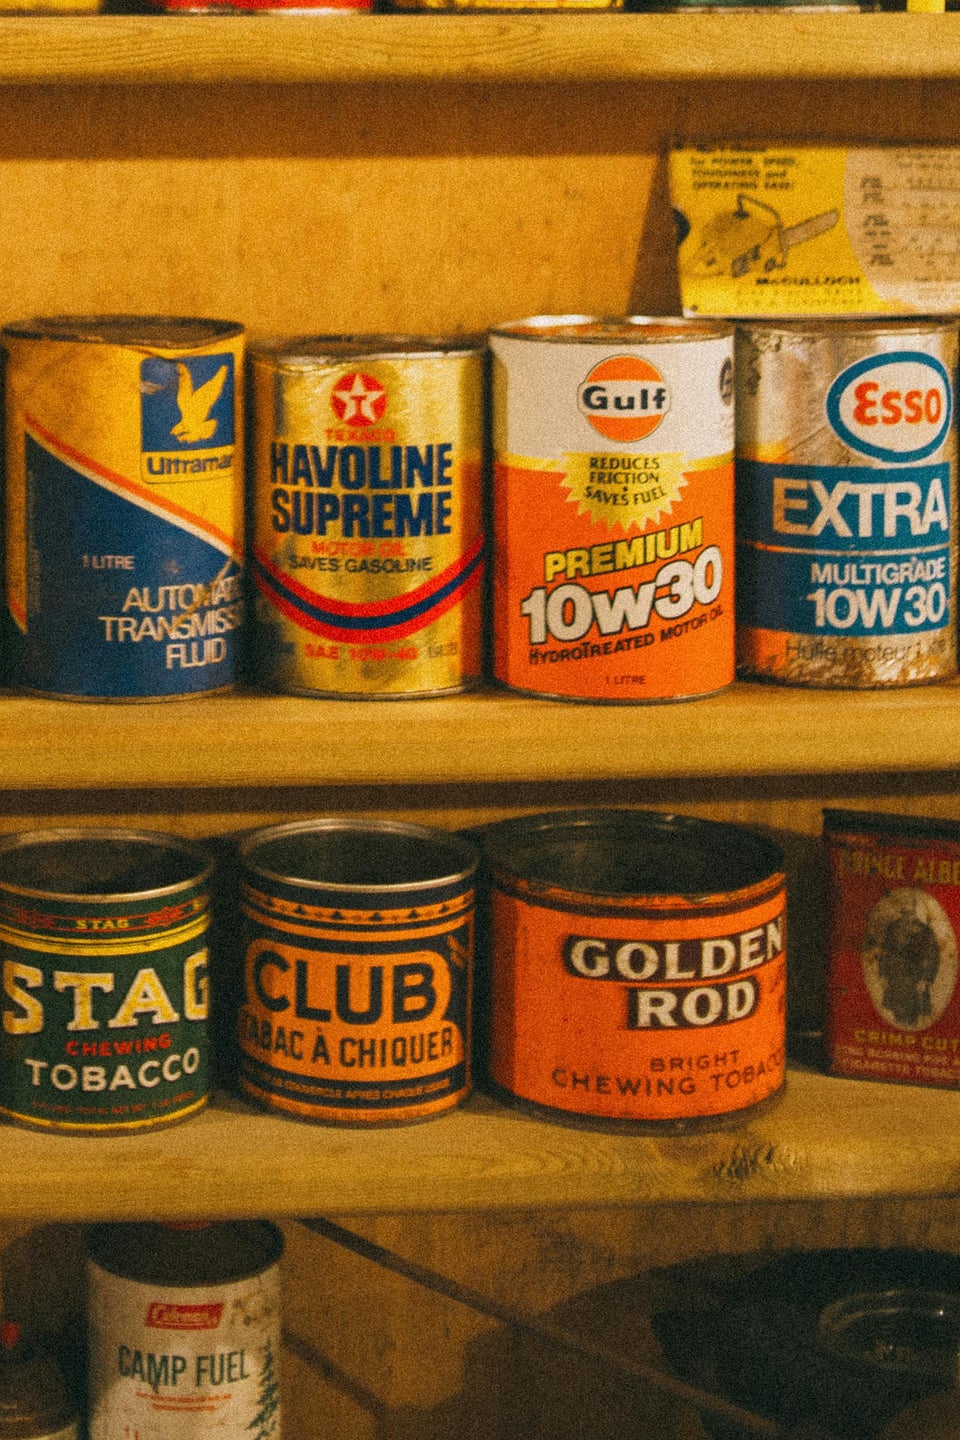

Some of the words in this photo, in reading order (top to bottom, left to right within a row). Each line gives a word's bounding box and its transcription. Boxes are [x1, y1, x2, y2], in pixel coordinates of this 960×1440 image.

[582, 385, 667, 411] Gulf
[853, 381, 942, 427] Esso
[270, 442, 453, 491] HAVOLINE
[589, 456, 660, 471] REDUCES
[589, 471, 660, 485] FRICTION
[583, 486, 630, 507] SAVES
[633, 487, 668, 506] FUEL
[772, 476, 949, 539] EXTRA
[270, 487, 453, 539] SUPREME
[311, 540, 375, 558] MOTOR
[378, 541, 406, 558] OIL
[344, 556, 434, 574] GASOLINE
[544, 517, 704, 583] PREMIUM
[810, 557, 946, 586] MULTIGRADE
[806, 587, 902, 630] 10W
[903, 581, 947, 628] 30
[659, 614, 709, 642] MOTOR
[165, 637, 228, 669] FLUID
[304, 643, 340, 661] SAE
[76, 919, 130, 931] STAG
[569, 916, 784, 982] GOLDEN
[1, 947, 210, 1036] STAG
[252, 949, 437, 1027] CLUB
[637, 979, 756, 1029] ROD
[65, 1033, 173, 1058] CHEWING
[339, 1026, 453, 1068] CHIQUER
[649, 1049, 740, 1073] BRIGHT
[24, 1046, 201, 1092] TOBACCO
[550, 1068, 697, 1097] CHEWING
[117, 1344, 187, 1387] CAMP
[195, 1349, 250, 1388] FUEL
